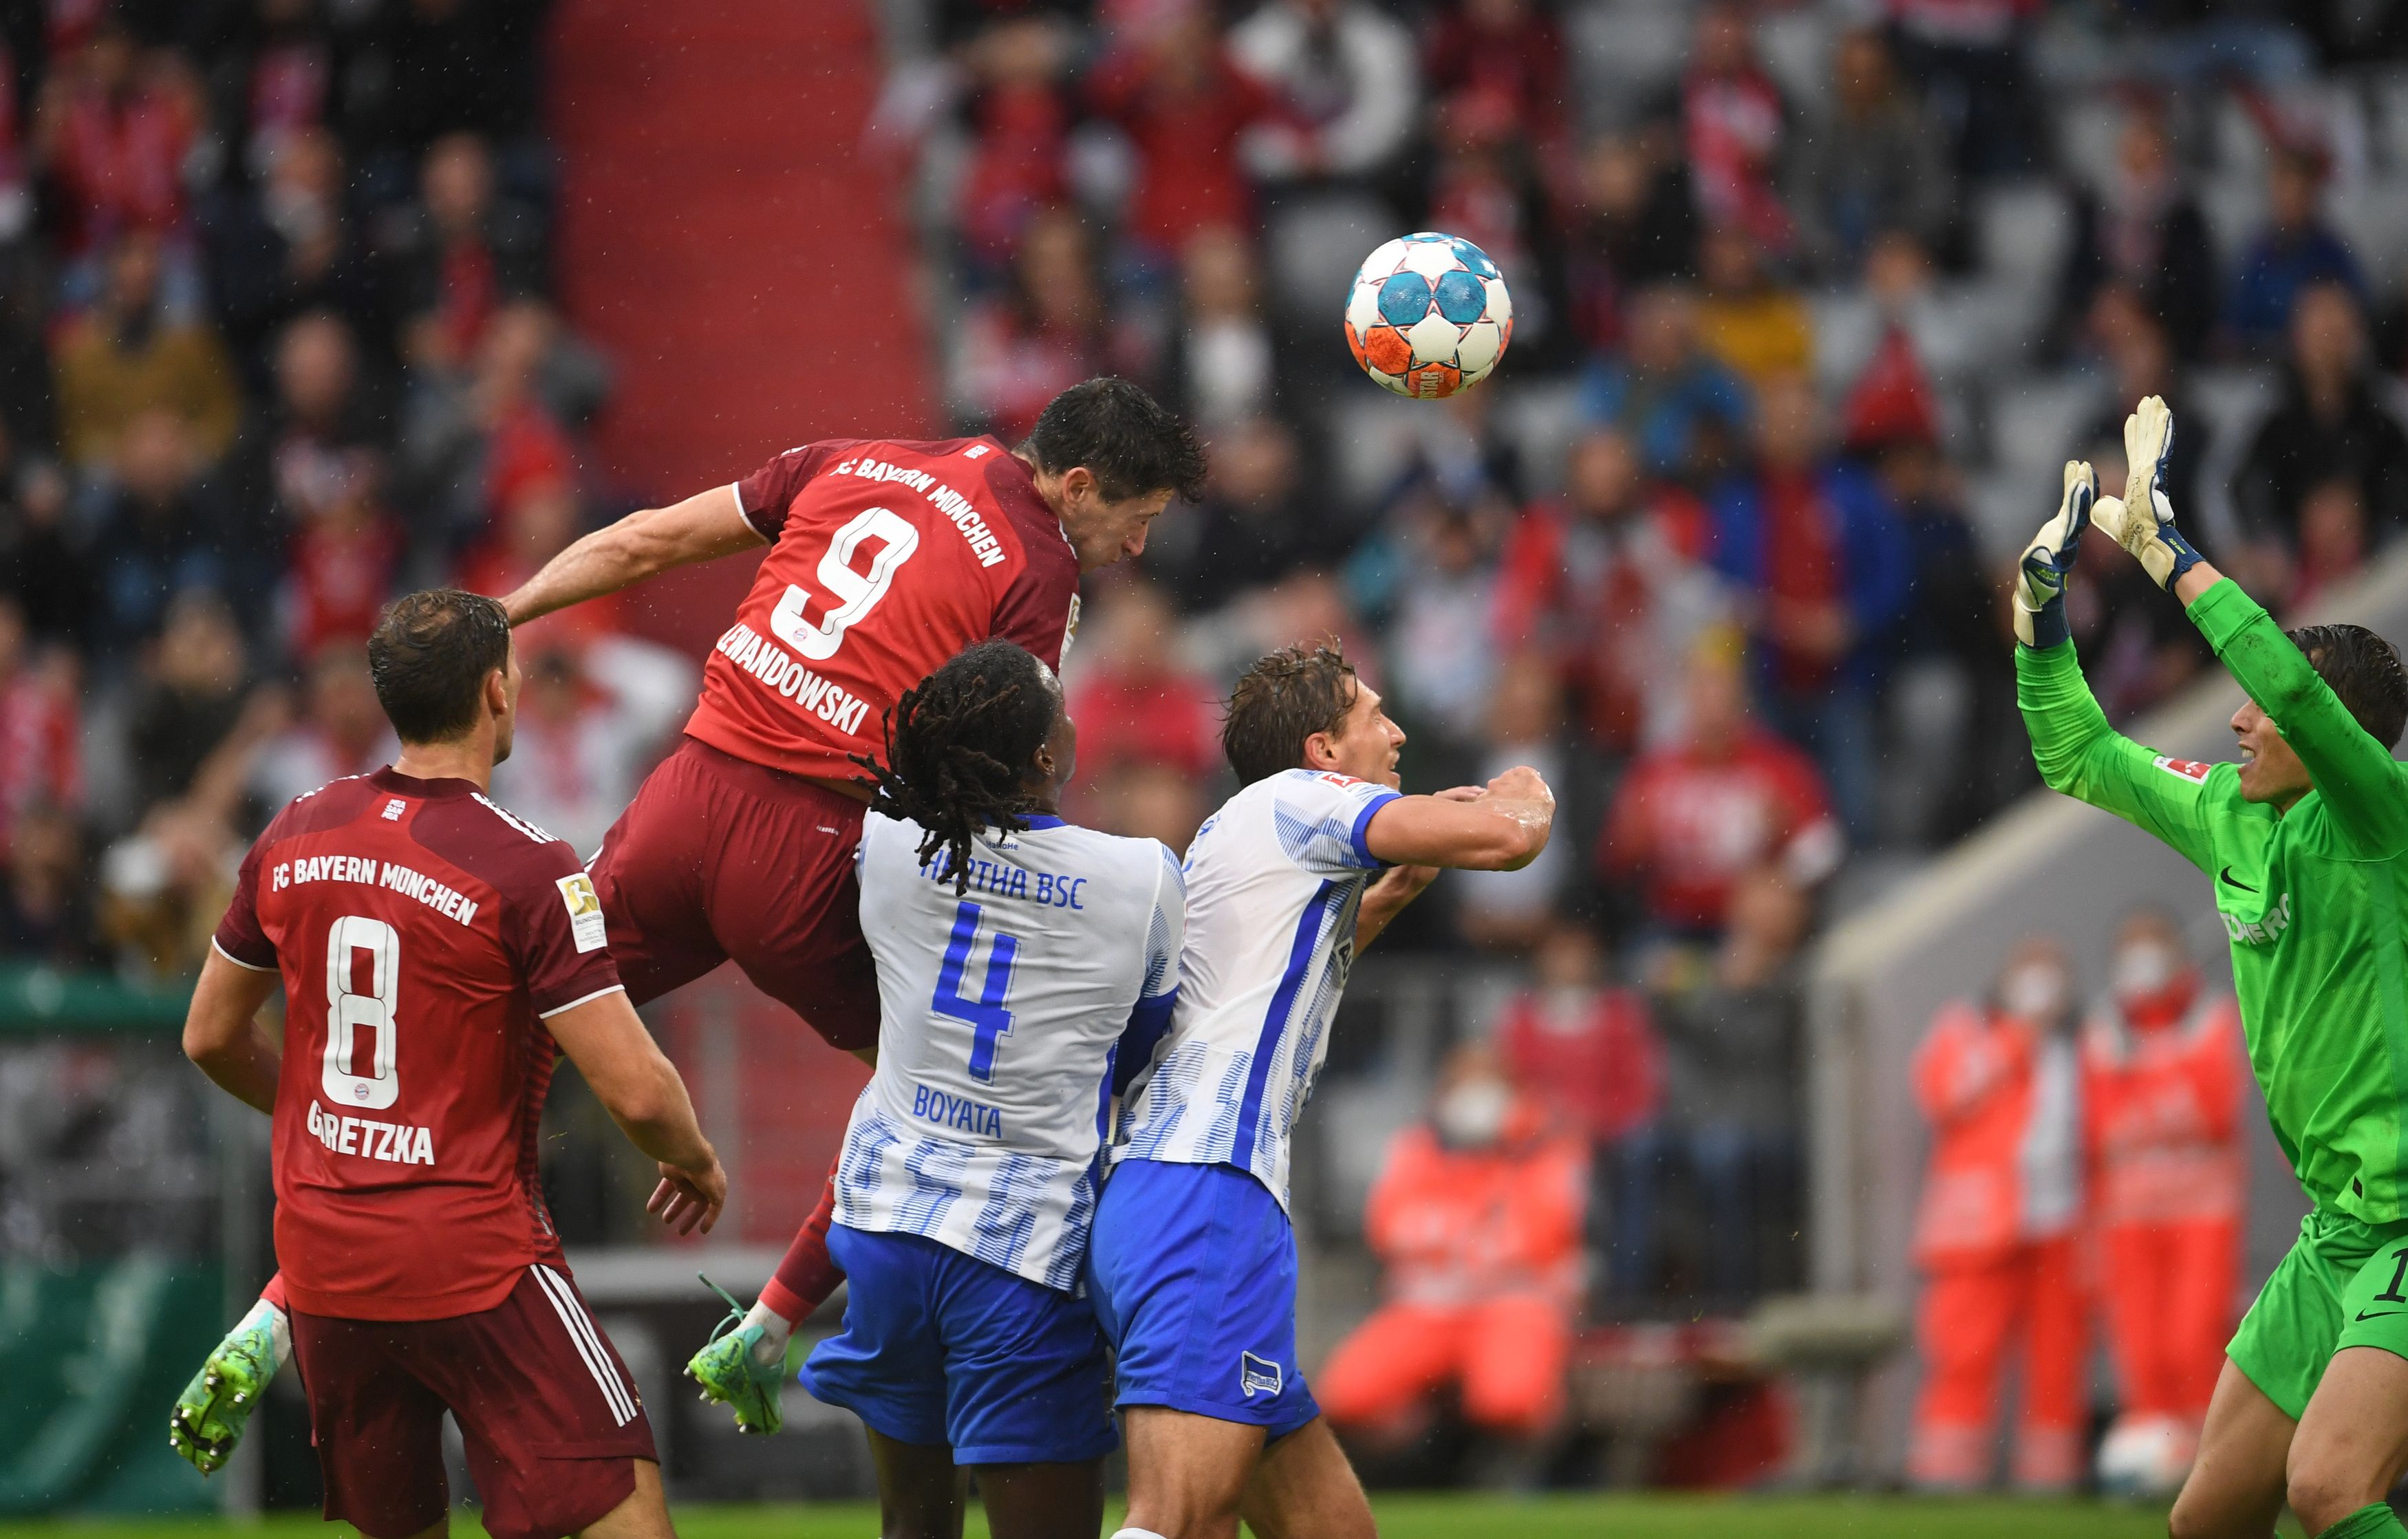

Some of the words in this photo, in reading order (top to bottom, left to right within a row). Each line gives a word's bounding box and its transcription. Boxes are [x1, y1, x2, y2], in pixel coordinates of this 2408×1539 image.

[828, 458, 859, 477] FC
[854, 458, 936, 493] BAYERN
[926, 484, 1007, 568] MÜNCHEN
[771, 506, 920, 660] 9
[272, 863, 290, 892] FC
[294, 855, 378, 885] BAYERN
[379, 861, 479, 927] MÜNCHEN
[1036, 872, 1088, 910] BSC
[321, 916, 400, 1110] 8
[931, 901, 1022, 1086] 4
[912, 1084, 1002, 1139] BOYATA
